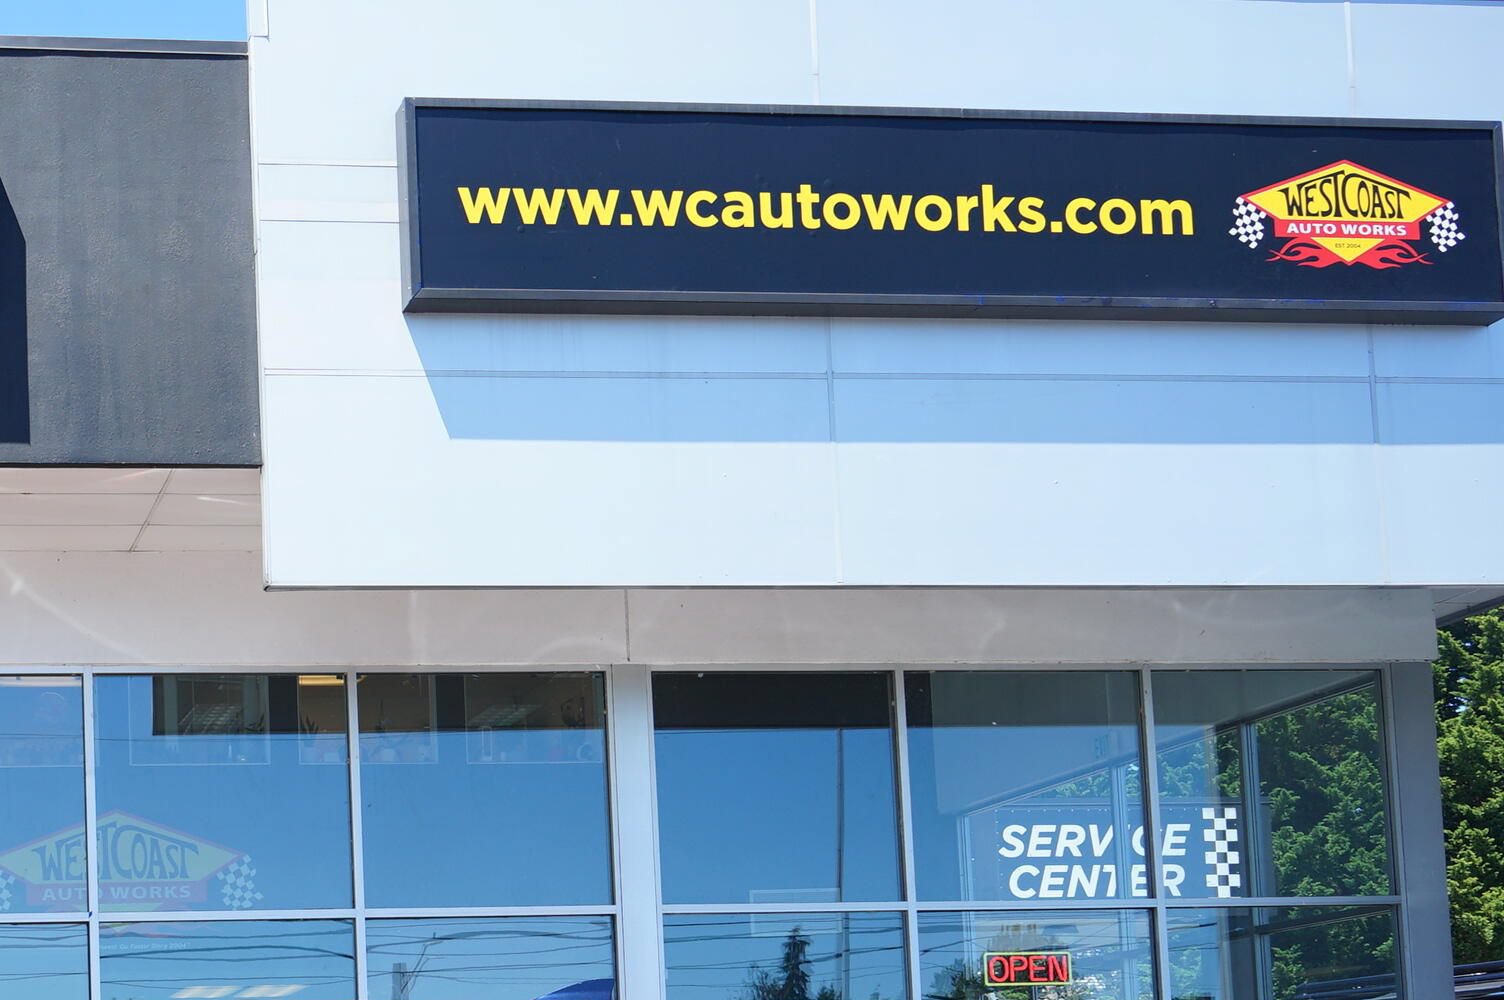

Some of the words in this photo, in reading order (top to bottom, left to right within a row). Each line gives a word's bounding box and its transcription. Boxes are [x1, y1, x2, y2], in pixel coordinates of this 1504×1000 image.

[458, 184, 1195, 236] www.wcautoworks.com
[1287, 223, 1337, 234] AUTO
[1340, 223, 1408, 236] WORKS
[998, 823, 1191, 858] SERVCE
[42, 887, 103, 901] AUT
[110, 885, 192, 899] WORKS
[989, 955, 1068, 982] OPEN
